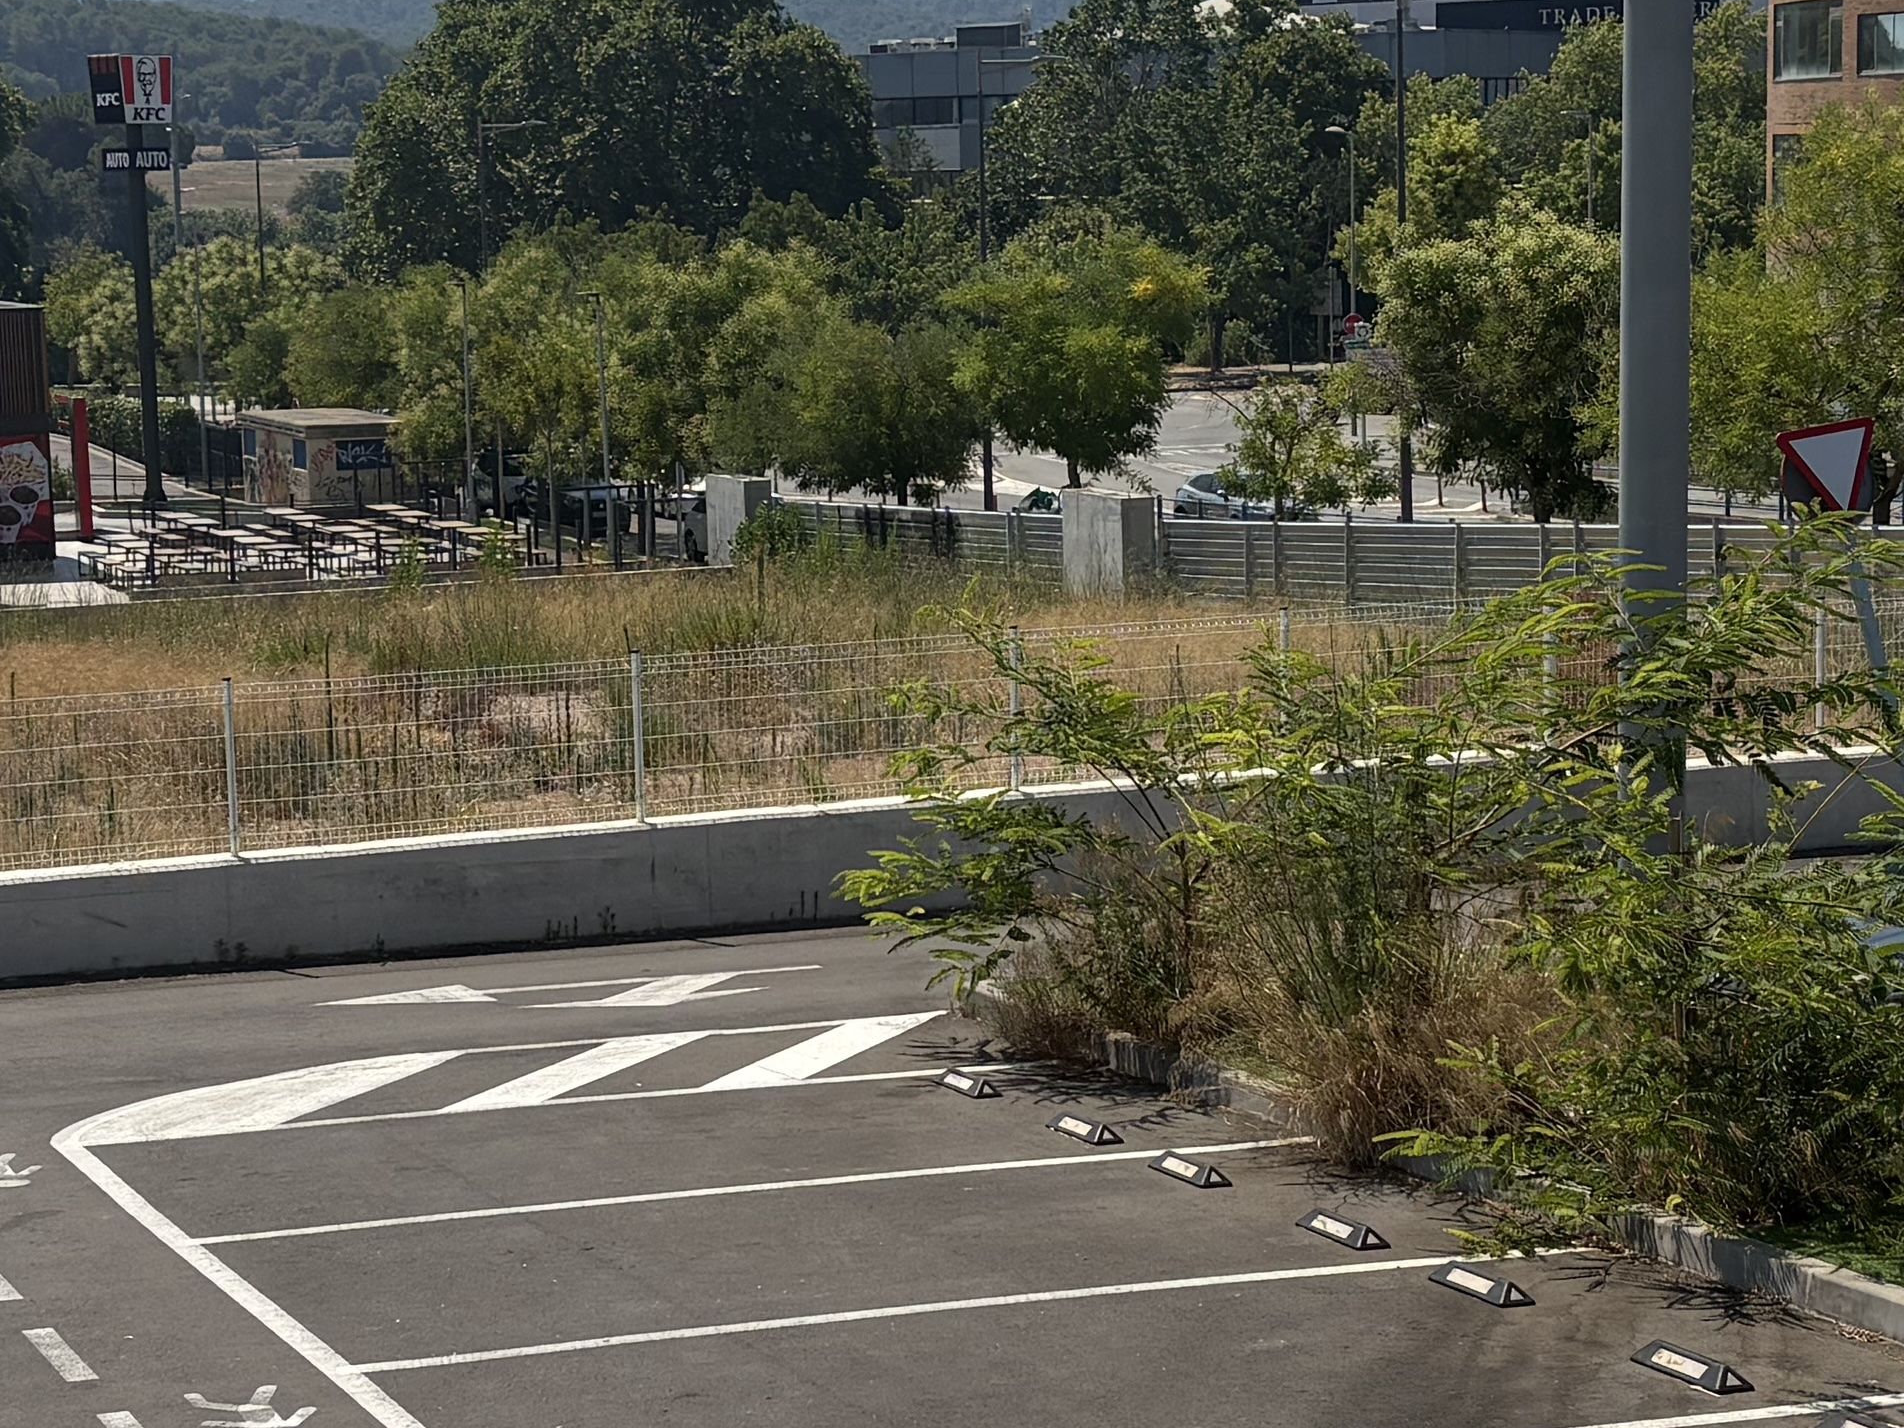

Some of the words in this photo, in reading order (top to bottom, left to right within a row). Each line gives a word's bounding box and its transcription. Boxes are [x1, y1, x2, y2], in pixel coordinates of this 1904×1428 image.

[96, 92, 121, 107] KFC
[133, 107, 166, 121] KFC
[106, 152, 130, 168] AUTO
[136, 151, 168, 168] AUTO
